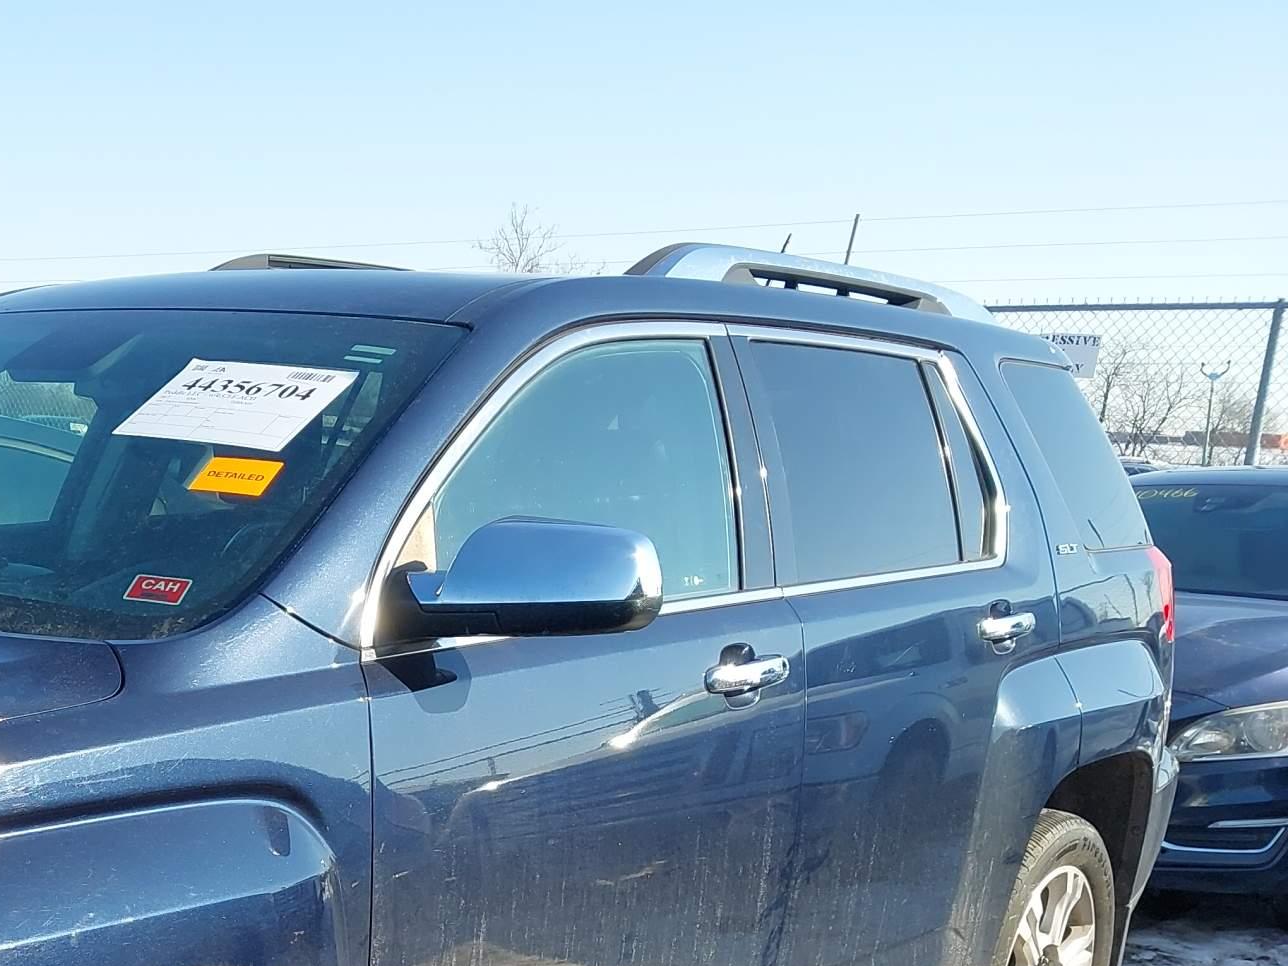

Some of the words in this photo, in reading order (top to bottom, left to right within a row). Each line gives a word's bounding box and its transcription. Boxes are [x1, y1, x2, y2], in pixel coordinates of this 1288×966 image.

[182, 377, 318, 401] 44356704
[206, 470, 266, 483] DETAILED
[141, 579, 181, 593] CAH
